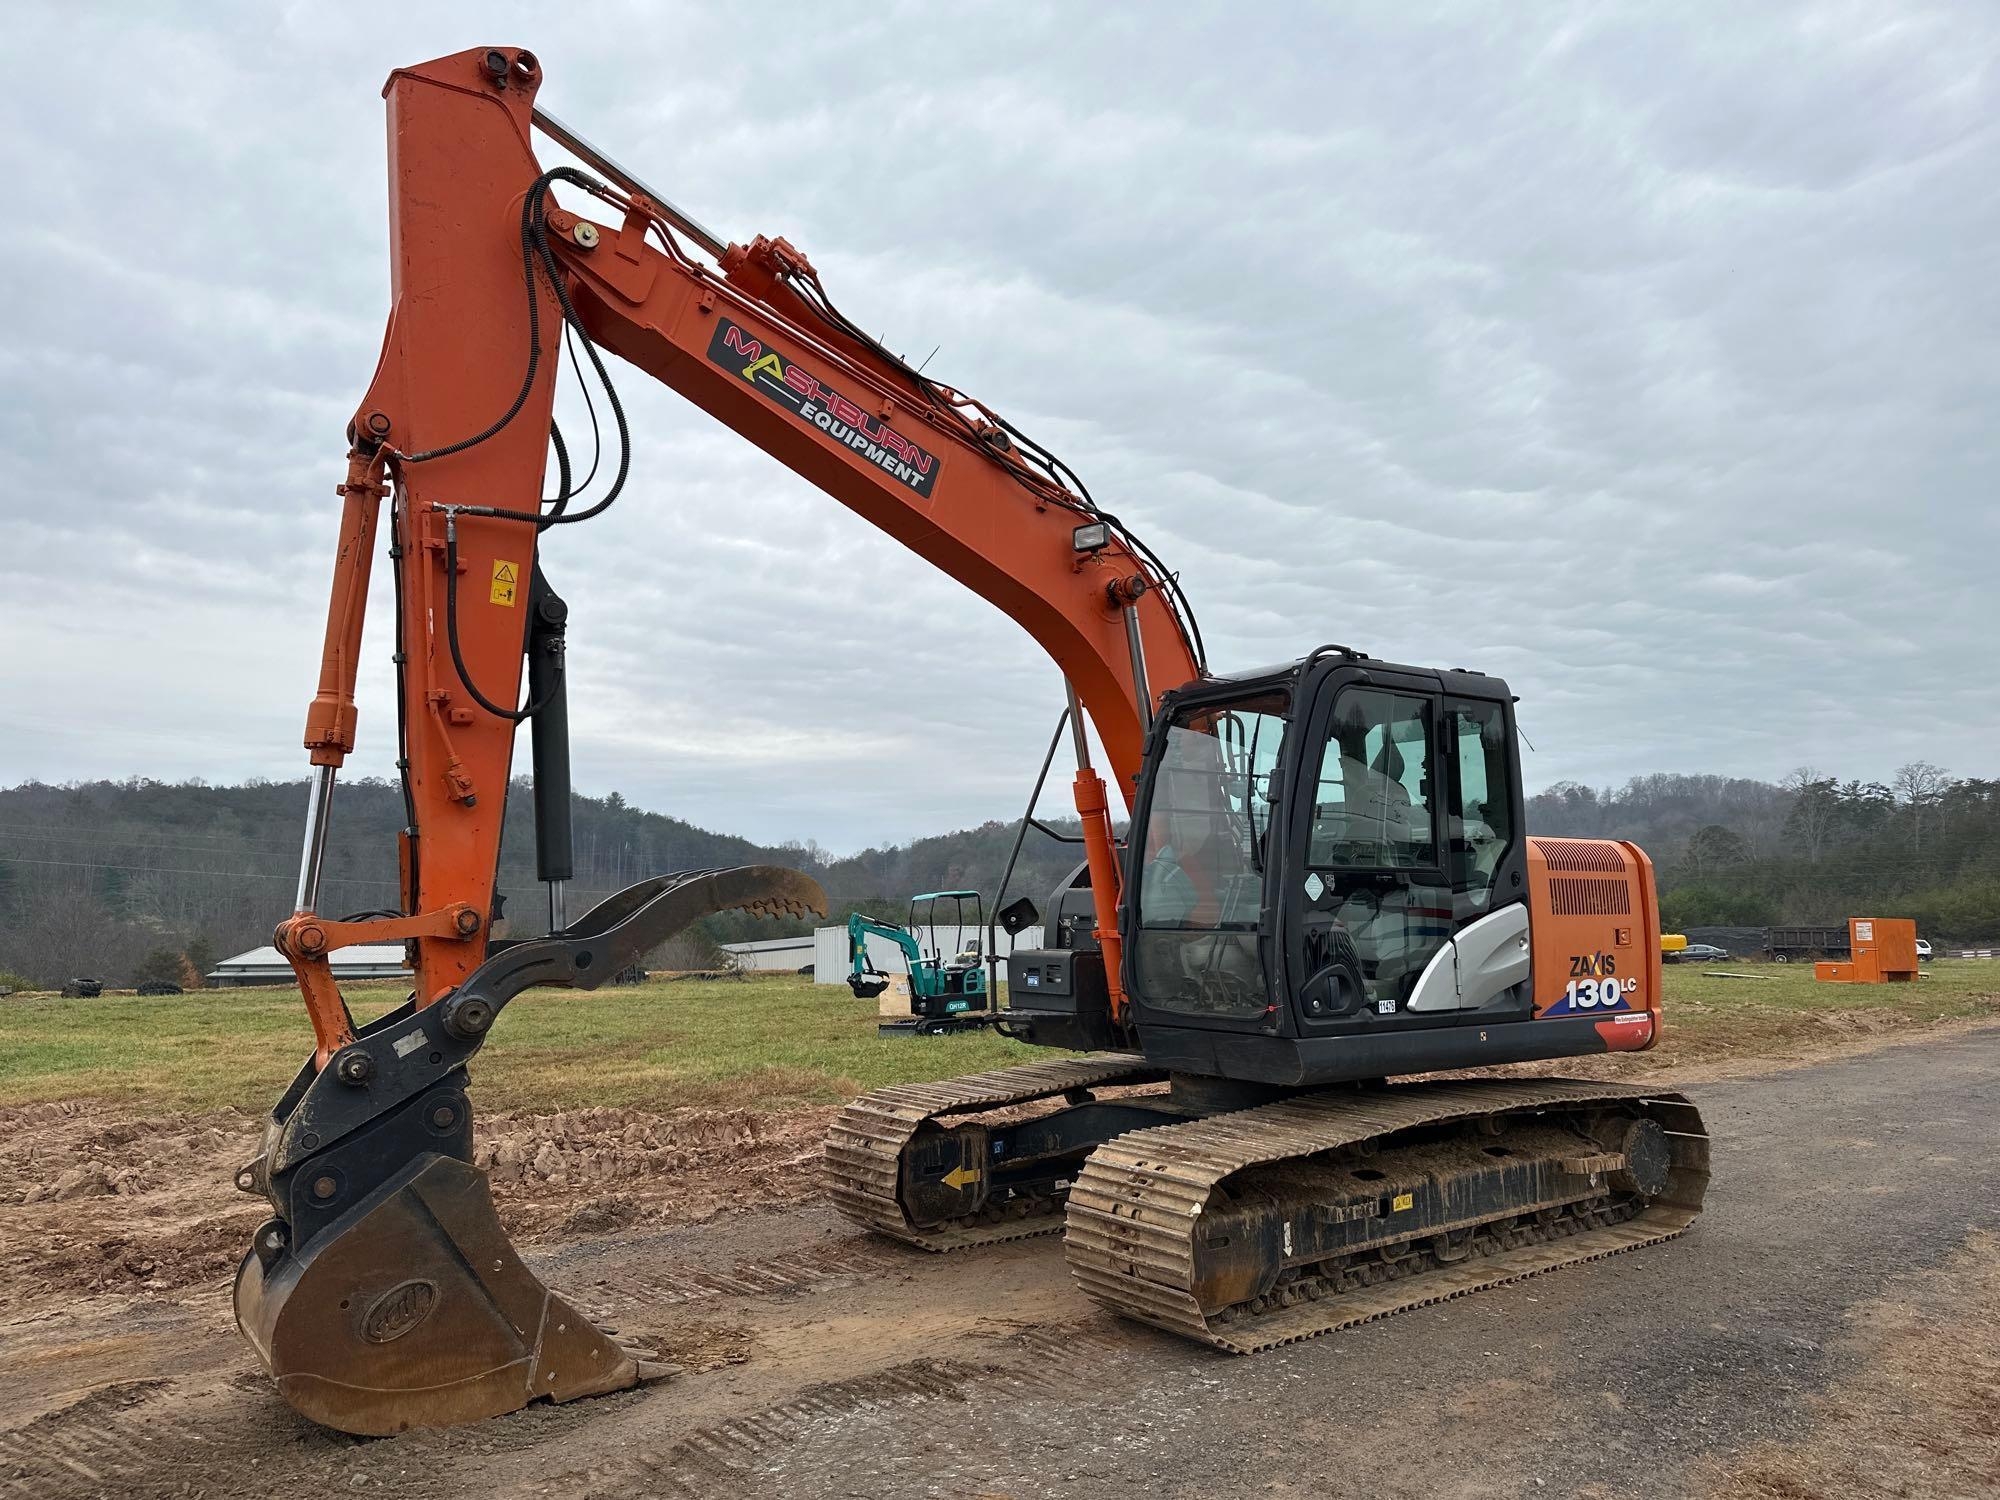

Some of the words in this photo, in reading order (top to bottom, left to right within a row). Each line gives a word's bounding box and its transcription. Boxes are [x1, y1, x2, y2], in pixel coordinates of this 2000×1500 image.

[723, 326, 932, 474] MASHBURN
[800, 401, 924, 487] EQUIPMENT
[1569, 951, 1616, 977] ZAXIS
